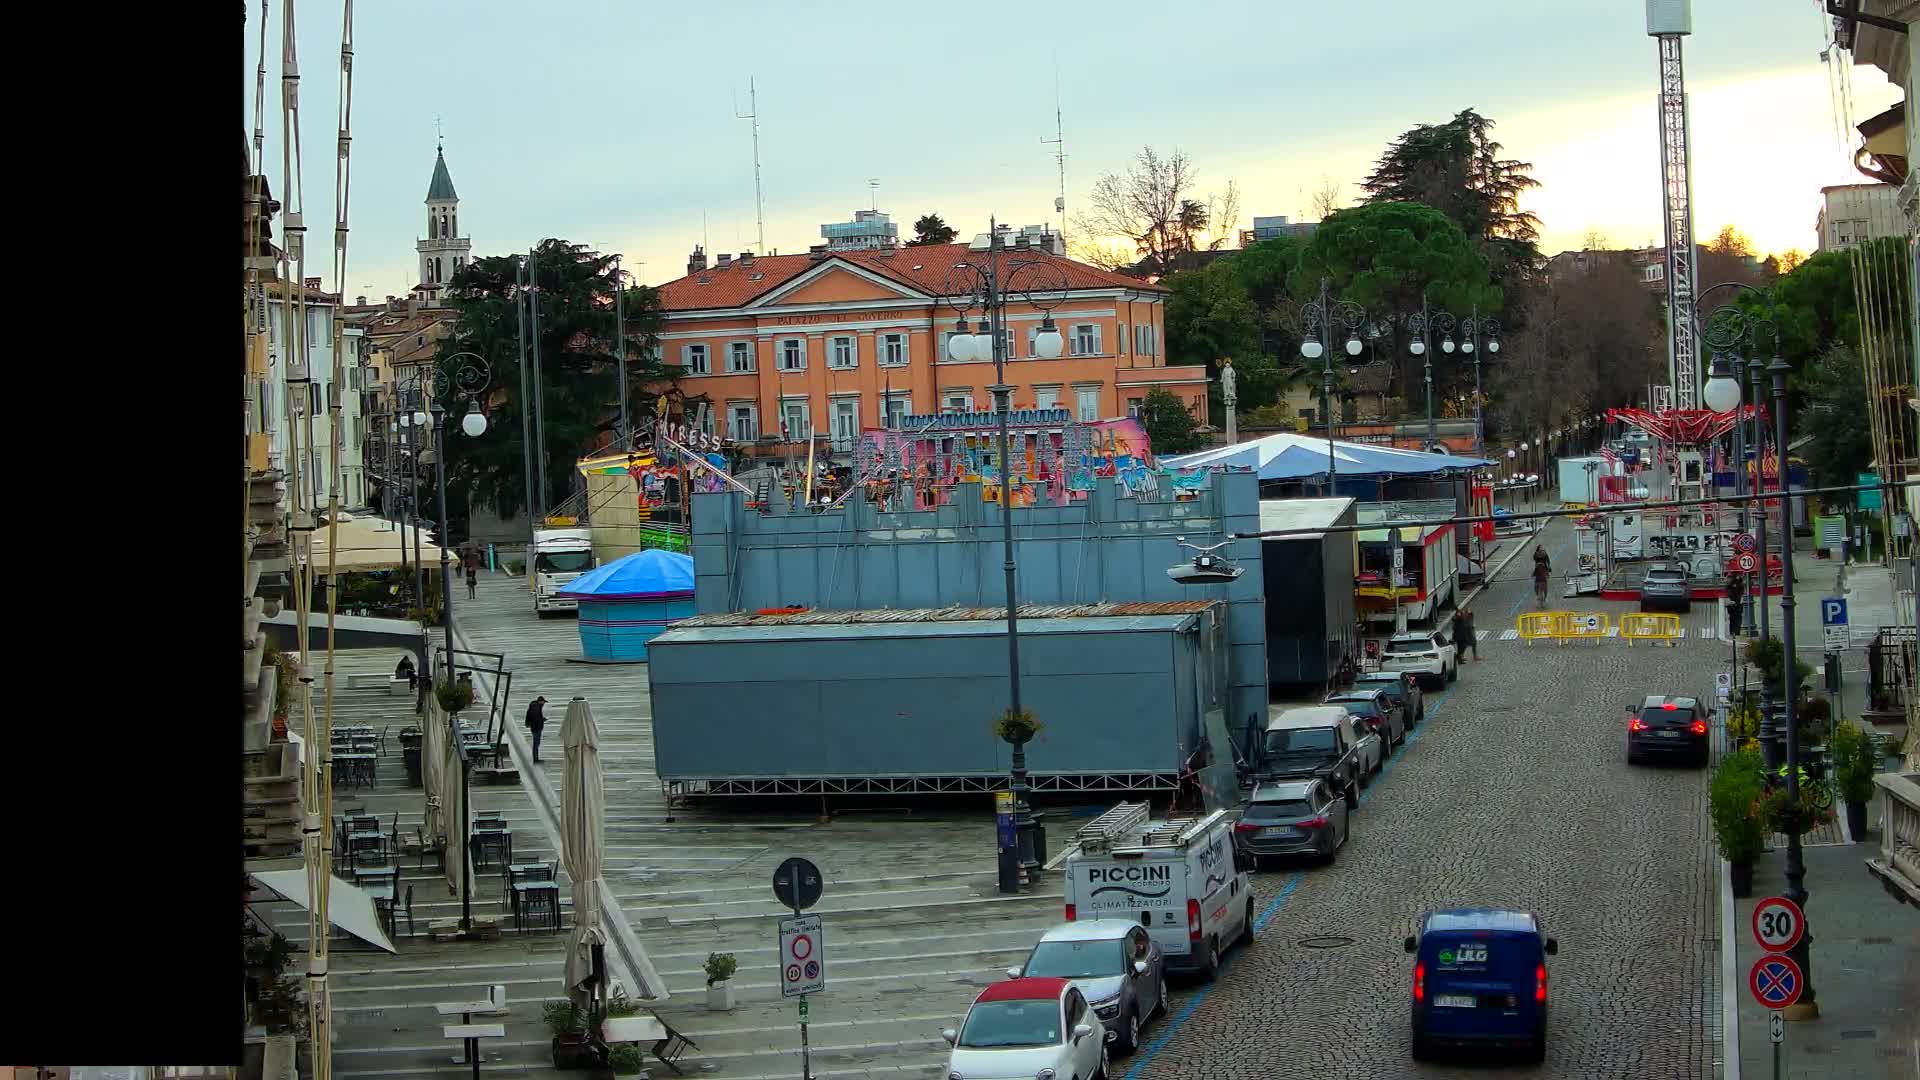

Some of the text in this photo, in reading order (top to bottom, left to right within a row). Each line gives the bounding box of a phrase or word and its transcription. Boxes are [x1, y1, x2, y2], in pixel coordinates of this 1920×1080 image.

[1742, 558, 1752, 567] 20
[1827, 602, 1842, 622] P
[1089, 865, 1170, 882] PICCINI
[1091, 899, 1172, 910] CLIMATIZZATORI
[1761, 911, 1791, 937] 30
